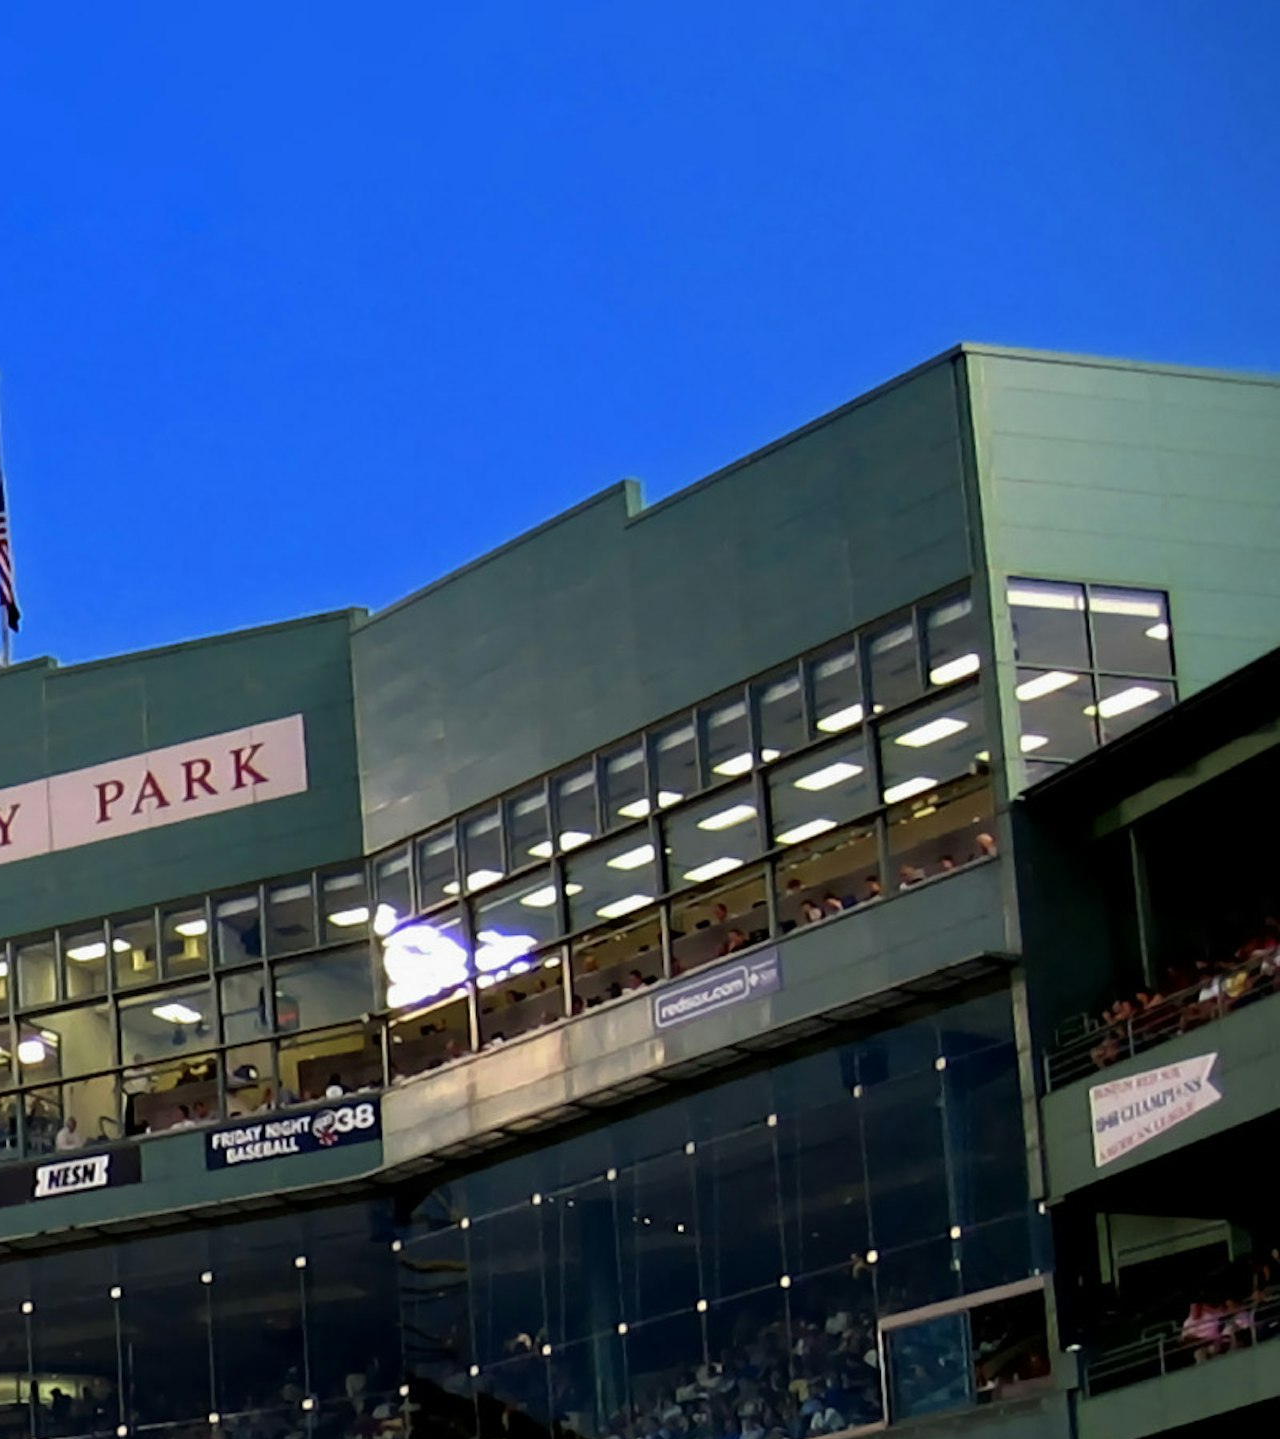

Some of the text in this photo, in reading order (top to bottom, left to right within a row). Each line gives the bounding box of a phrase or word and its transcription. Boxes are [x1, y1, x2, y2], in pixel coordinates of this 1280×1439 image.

[94, 742, 270, 824] PARK
[212, 1125, 263, 1150] FRIDAY
[265, 1115, 312, 1138] NIGHT
[226, 1137, 300, 1164] BASEBALL
[46, 1162, 98, 1191] NESN
